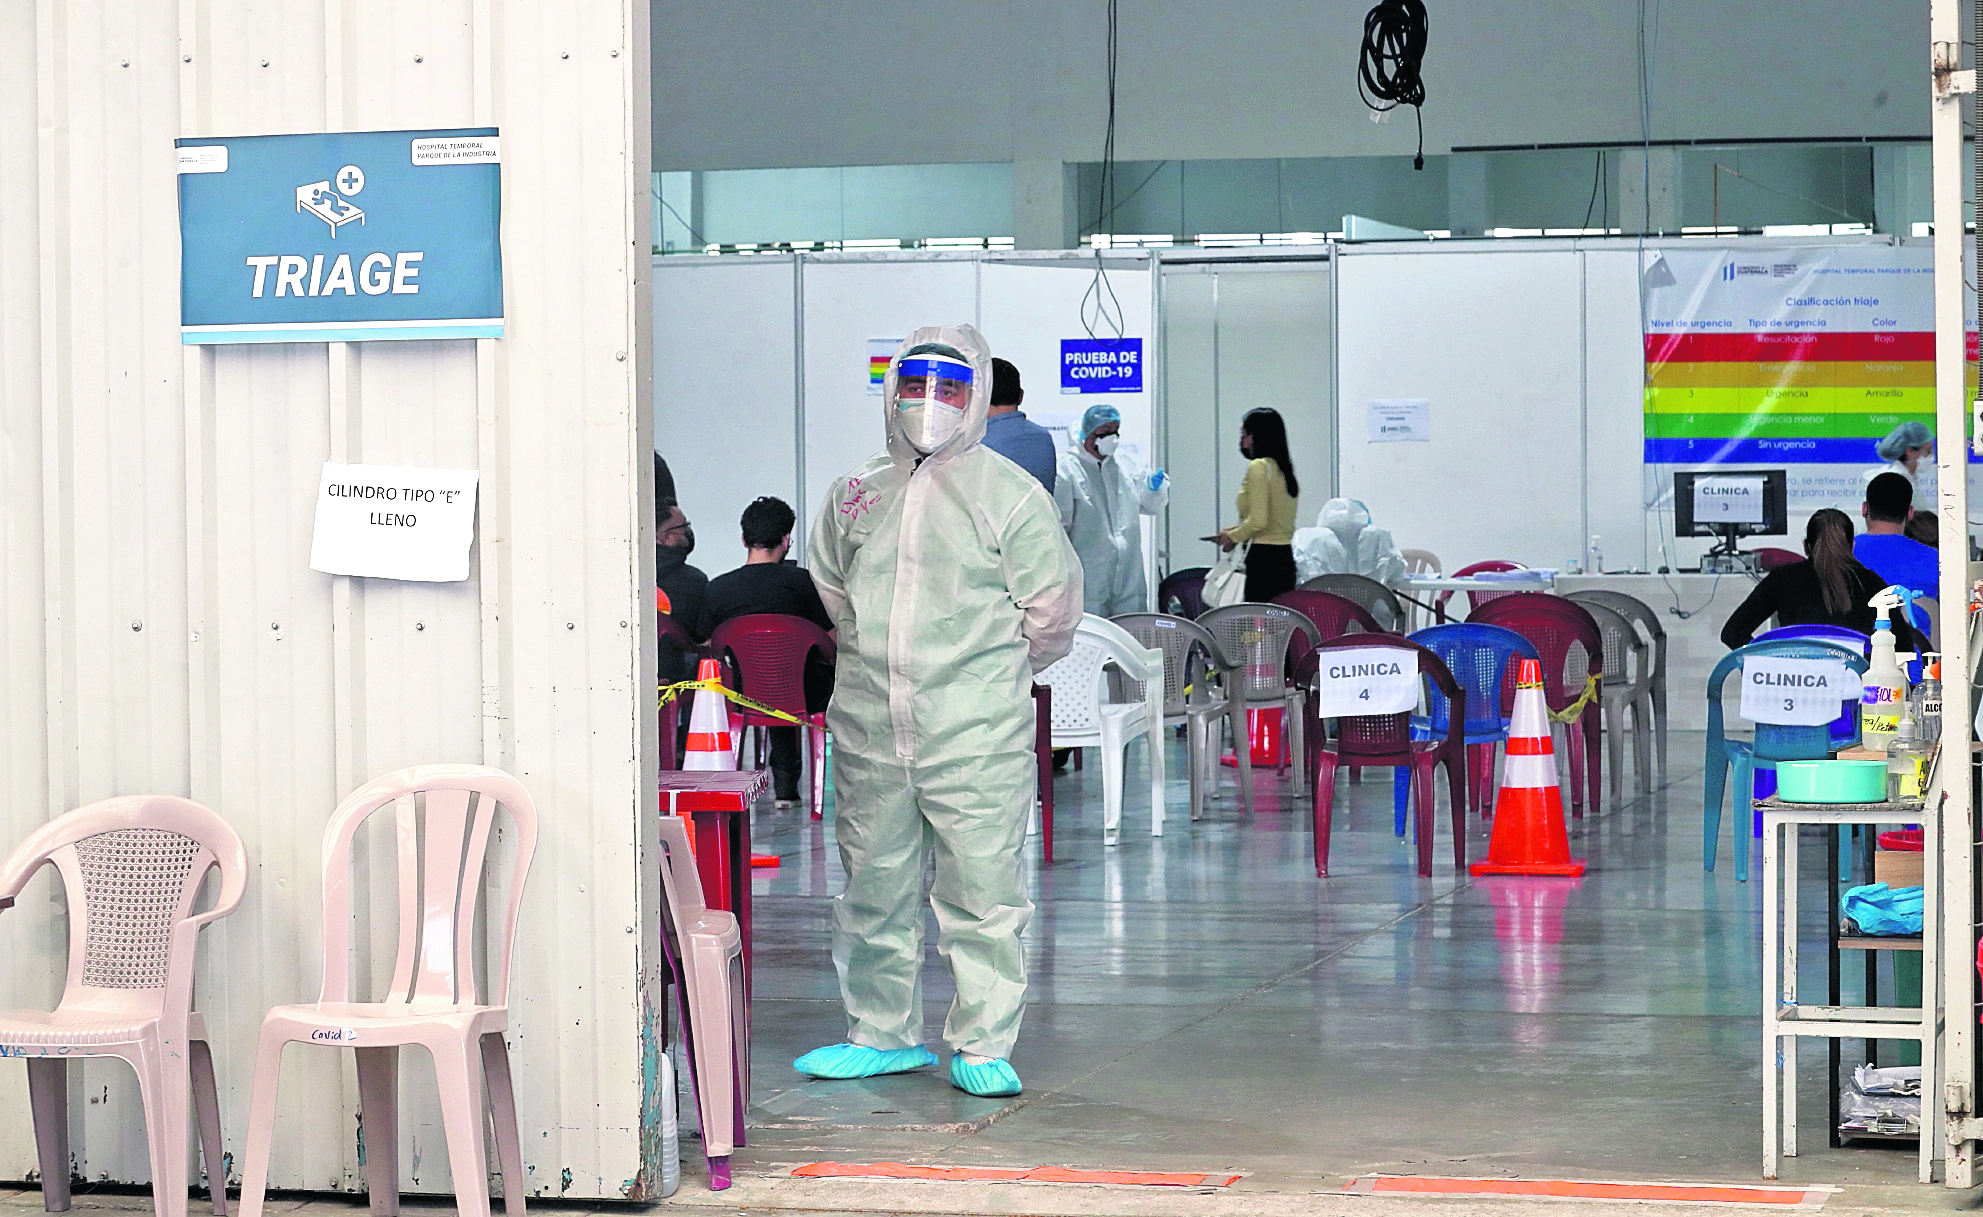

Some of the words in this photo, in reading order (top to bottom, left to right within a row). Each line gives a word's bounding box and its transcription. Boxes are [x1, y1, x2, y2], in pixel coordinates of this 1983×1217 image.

[417, 143, 448, 151] HOSPITAL
[449, 142, 484, 150] TEMPORAL
[462, 150, 497, 158] INDUSTRIA
[246, 251, 424, 298] TRIAGE
[1813, 267, 1842, 275] HOSPITAL
[1843, 267, 1876, 275] TEMPORAL
[1877, 267, 1902, 275] PARQUE
[1785, 296, 1851, 307] Clasificación
[1853, 296, 1880, 308] triaje
[1651, 319, 1674, 328] Nivel
[1676, 319, 1688, 328] de
[1690, 319, 1733, 330] urgencia
[1748, 318, 1767, 329] Tipo
[1769, 318, 1783, 328] de
[1784, 318, 1827, 329] urgencia
[1871, 317, 1898, 327] Color
[1756, 334, 1818, 344] Resucitación
[1874, 334, 1895, 345] Rojo
[1065, 351, 1117, 365] PRUEBA
[1119, 351, 1138, 364] DE
[1070, 366, 1133, 379] COVID-19
[1688, 363, 1694, 373] 2
[1865, 363, 1904, 374] Naranja
[1688, 389, 1694, 399] 3
[1766, 389, 1809, 400] Urgencia
[1865, 389, 1904, 398] Amarillo
[1688, 415, 1694, 424] 4
[1750, 414, 1792, 425] Urgencia
[1793, 415, 1825, 424] menor
[1869, 414, 1899, 424] Verde
[1688, 439, 1694, 449] 5
[1758, 439, 1772, 449] Sin
[1773, 439, 1816, 451] urgencia
[1801, 477, 1813, 486] se
[1814, 476, 1846, 486] refiere
[1847, 476, 1858, 486] al
[328, 483, 397, 501] CILINDRO
[402, 488, 435, 503] TIPO
[1702, 486, 1750, 496] CLINICA
[1801, 489, 1825, 498] para
[1826, 488, 1857, 498] recibir
[1721, 502, 1729, 512] 3
[370, 512, 417, 527] LLENO
[1329, 663, 1401, 679] CLINICA
[1752, 672, 1828, 688] CLINICA
[1359, 688, 1370, 701] 4
[1783, 698, 1794, 711] 3
[311, 1028, 342, 1040] Covid
[347, 1030, 357, 1041] 2
